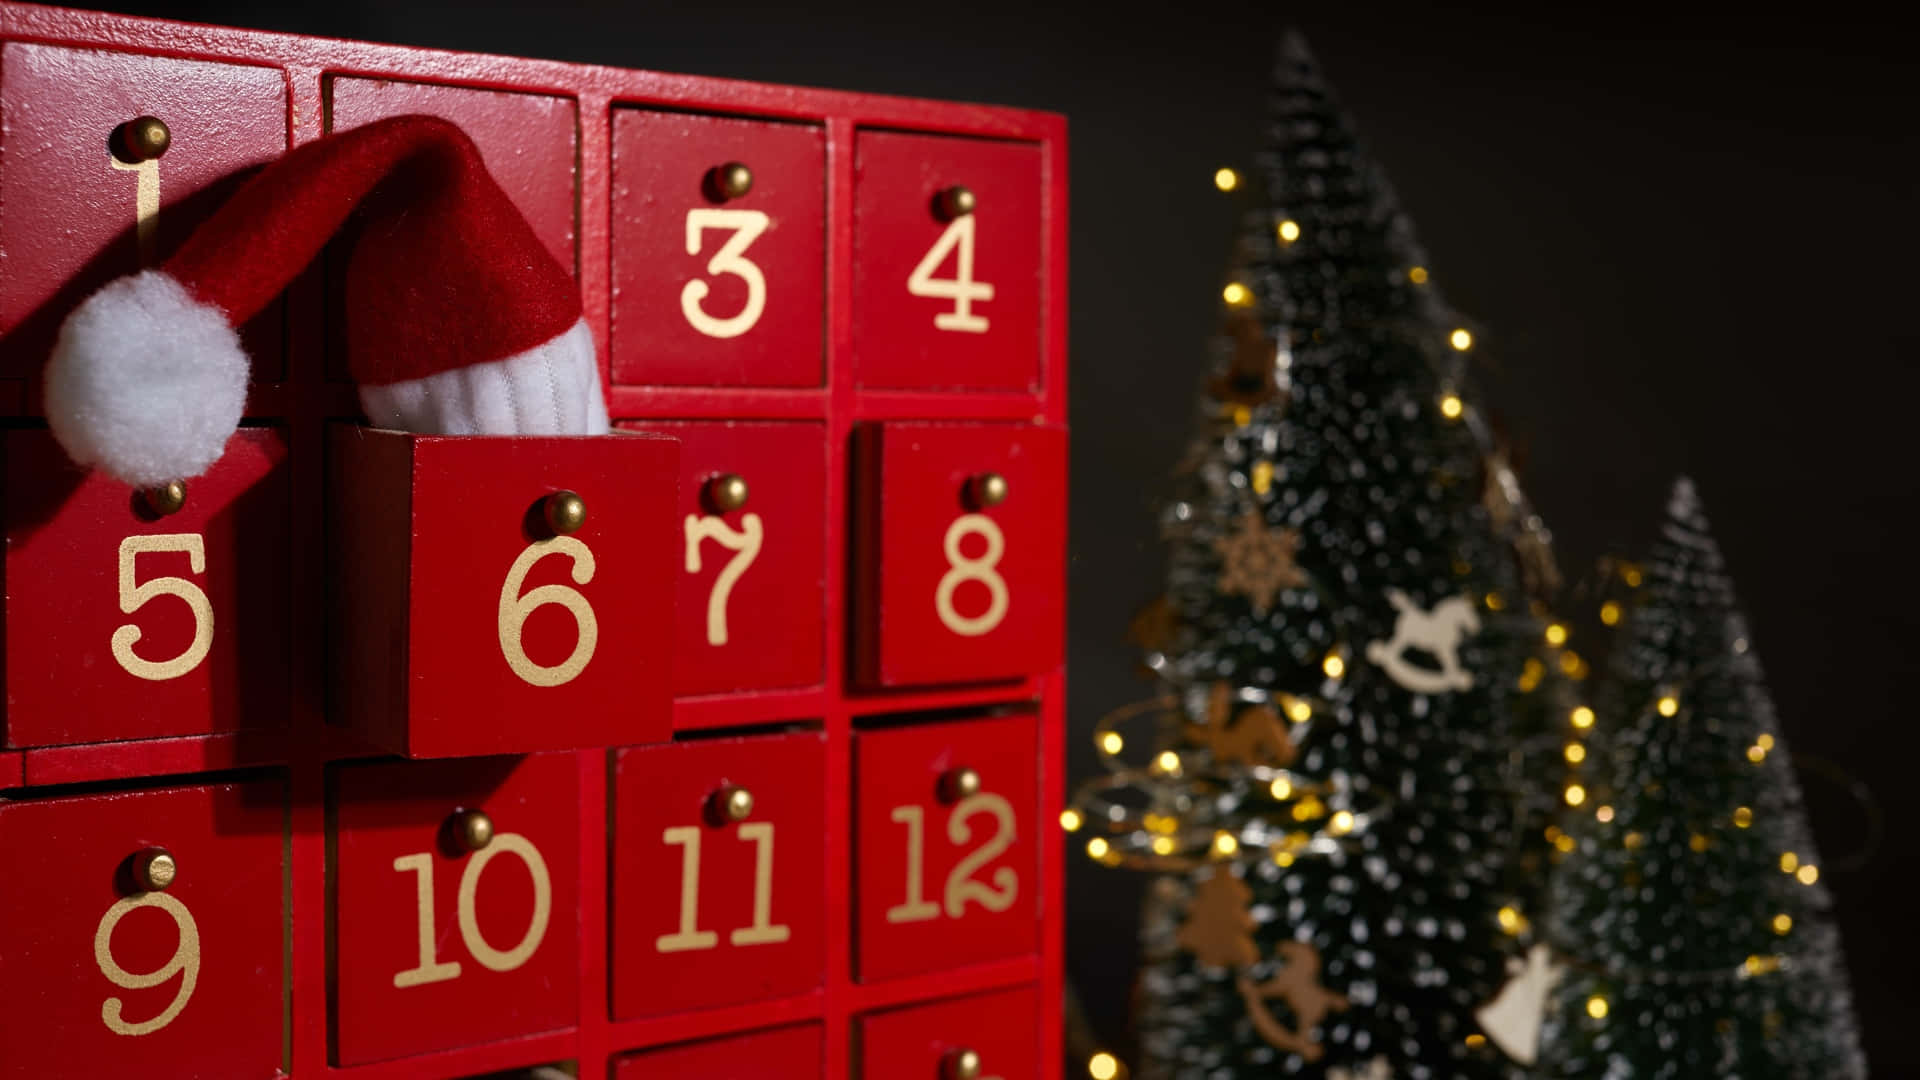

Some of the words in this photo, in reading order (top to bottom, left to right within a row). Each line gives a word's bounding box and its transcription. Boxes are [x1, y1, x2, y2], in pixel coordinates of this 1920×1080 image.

[110, 155, 161, 258] 1
[680, 208, 770, 338] 3
[907, 215, 994, 332] 4
[111, 533, 214, 680] 5
[498, 535, 598, 686] 6
[684, 513, 763, 645] 7
[936, 514, 1009, 635] 8
[393, 833, 551, 988] 10
[656, 822, 790, 953] 11
[887, 794, 1018, 923] 12
[94, 892, 201, 1036] 9
